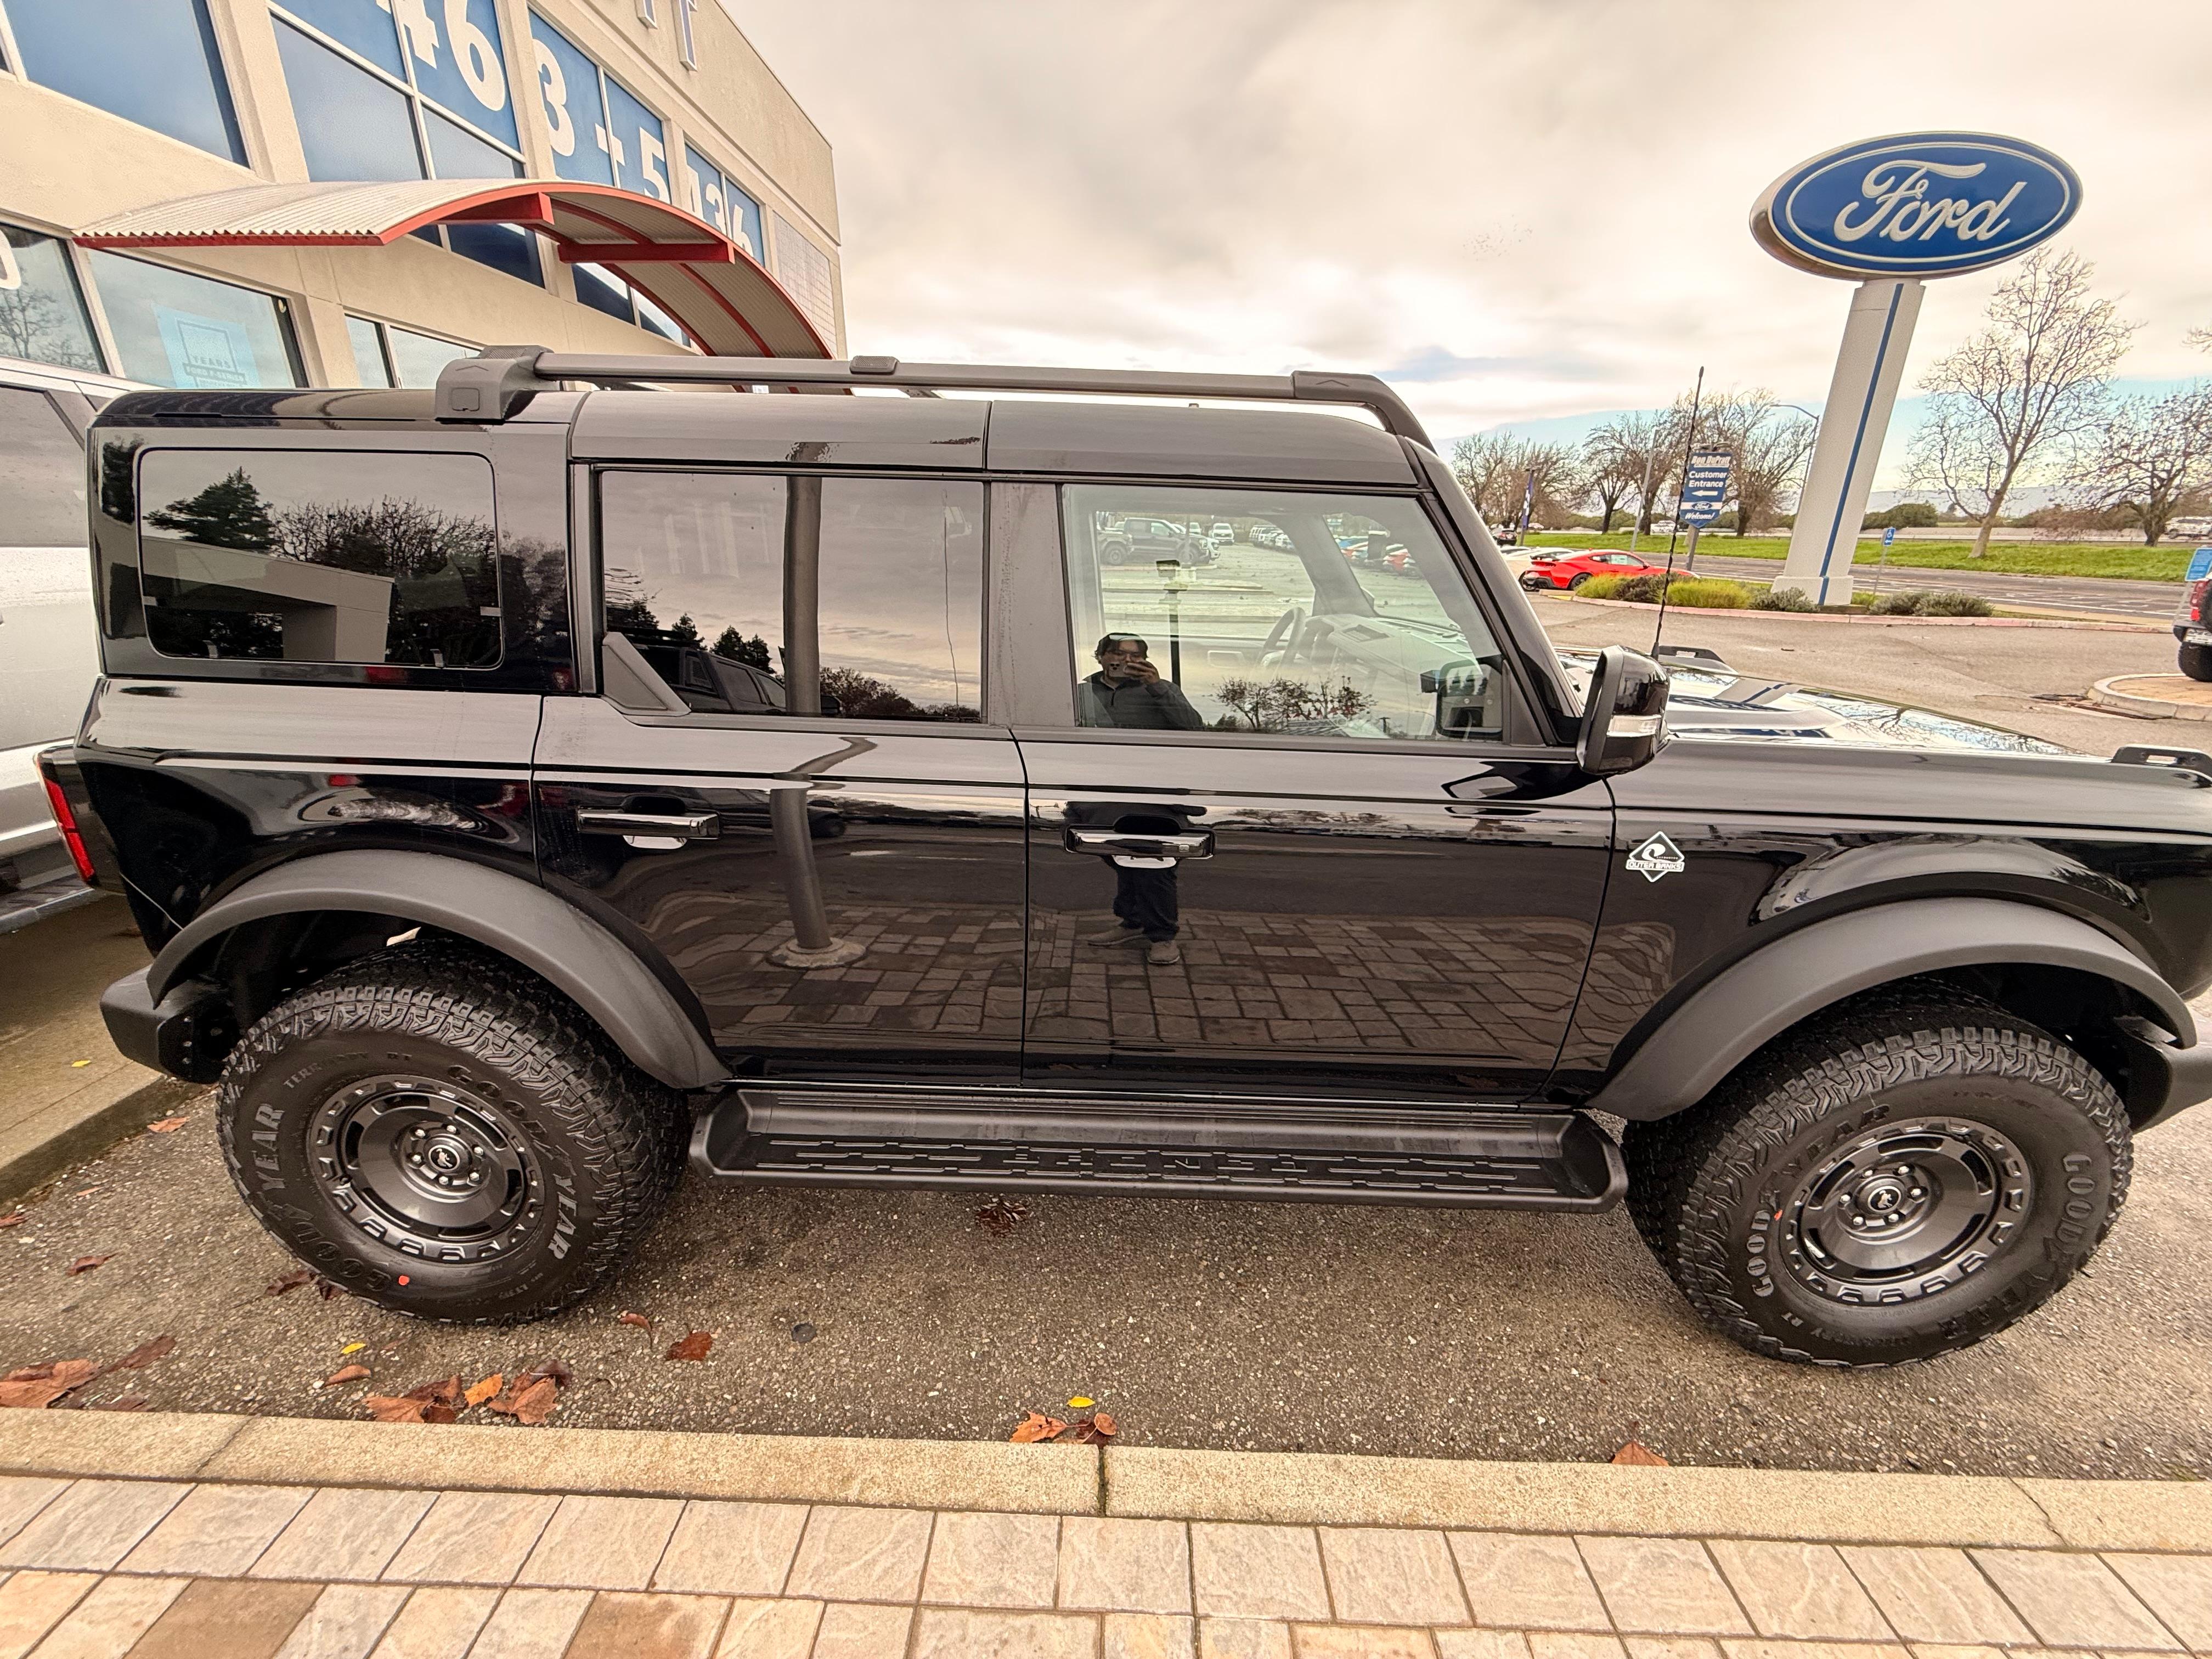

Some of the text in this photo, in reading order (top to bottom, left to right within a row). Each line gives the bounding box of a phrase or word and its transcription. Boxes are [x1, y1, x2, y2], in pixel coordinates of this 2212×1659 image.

[1834, 160, 2028, 242] Ford
[191, 356, 231, 369] YEARS
[1689, 471, 1727, 479] Customer
